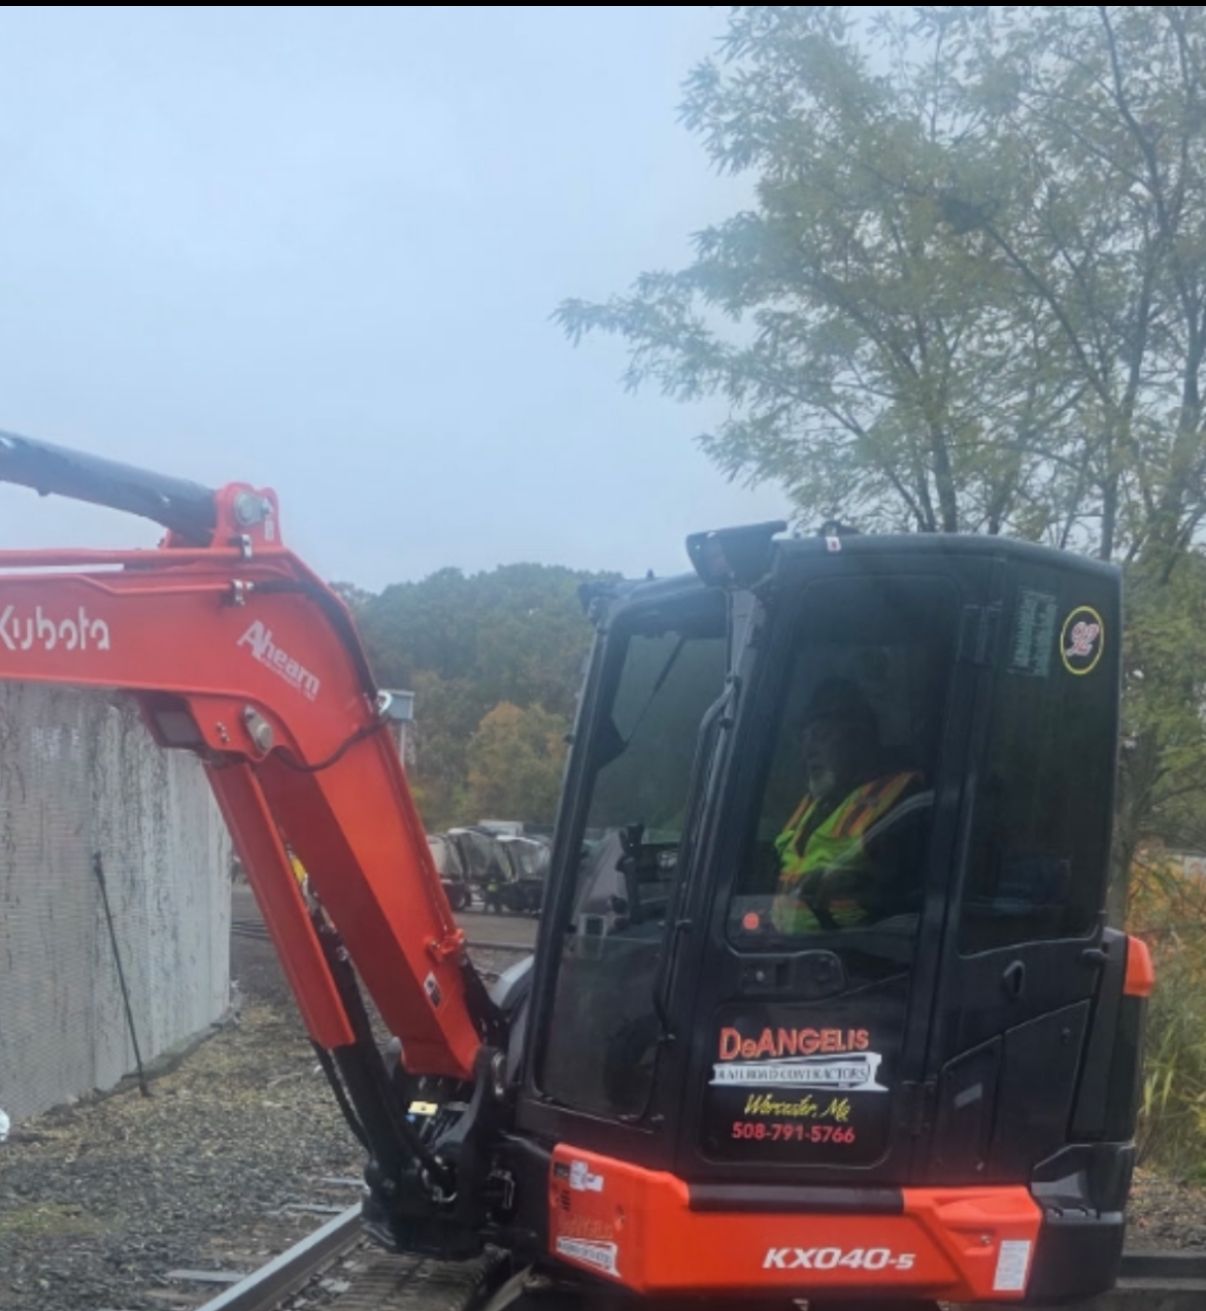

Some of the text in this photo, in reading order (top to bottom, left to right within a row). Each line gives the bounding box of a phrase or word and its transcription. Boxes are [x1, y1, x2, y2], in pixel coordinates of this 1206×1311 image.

[237, 620, 319, 698] Ahearn
[719, 1026, 869, 1060] DeANGELIS
[732, 1121, 856, 1144] 508-791-5766
